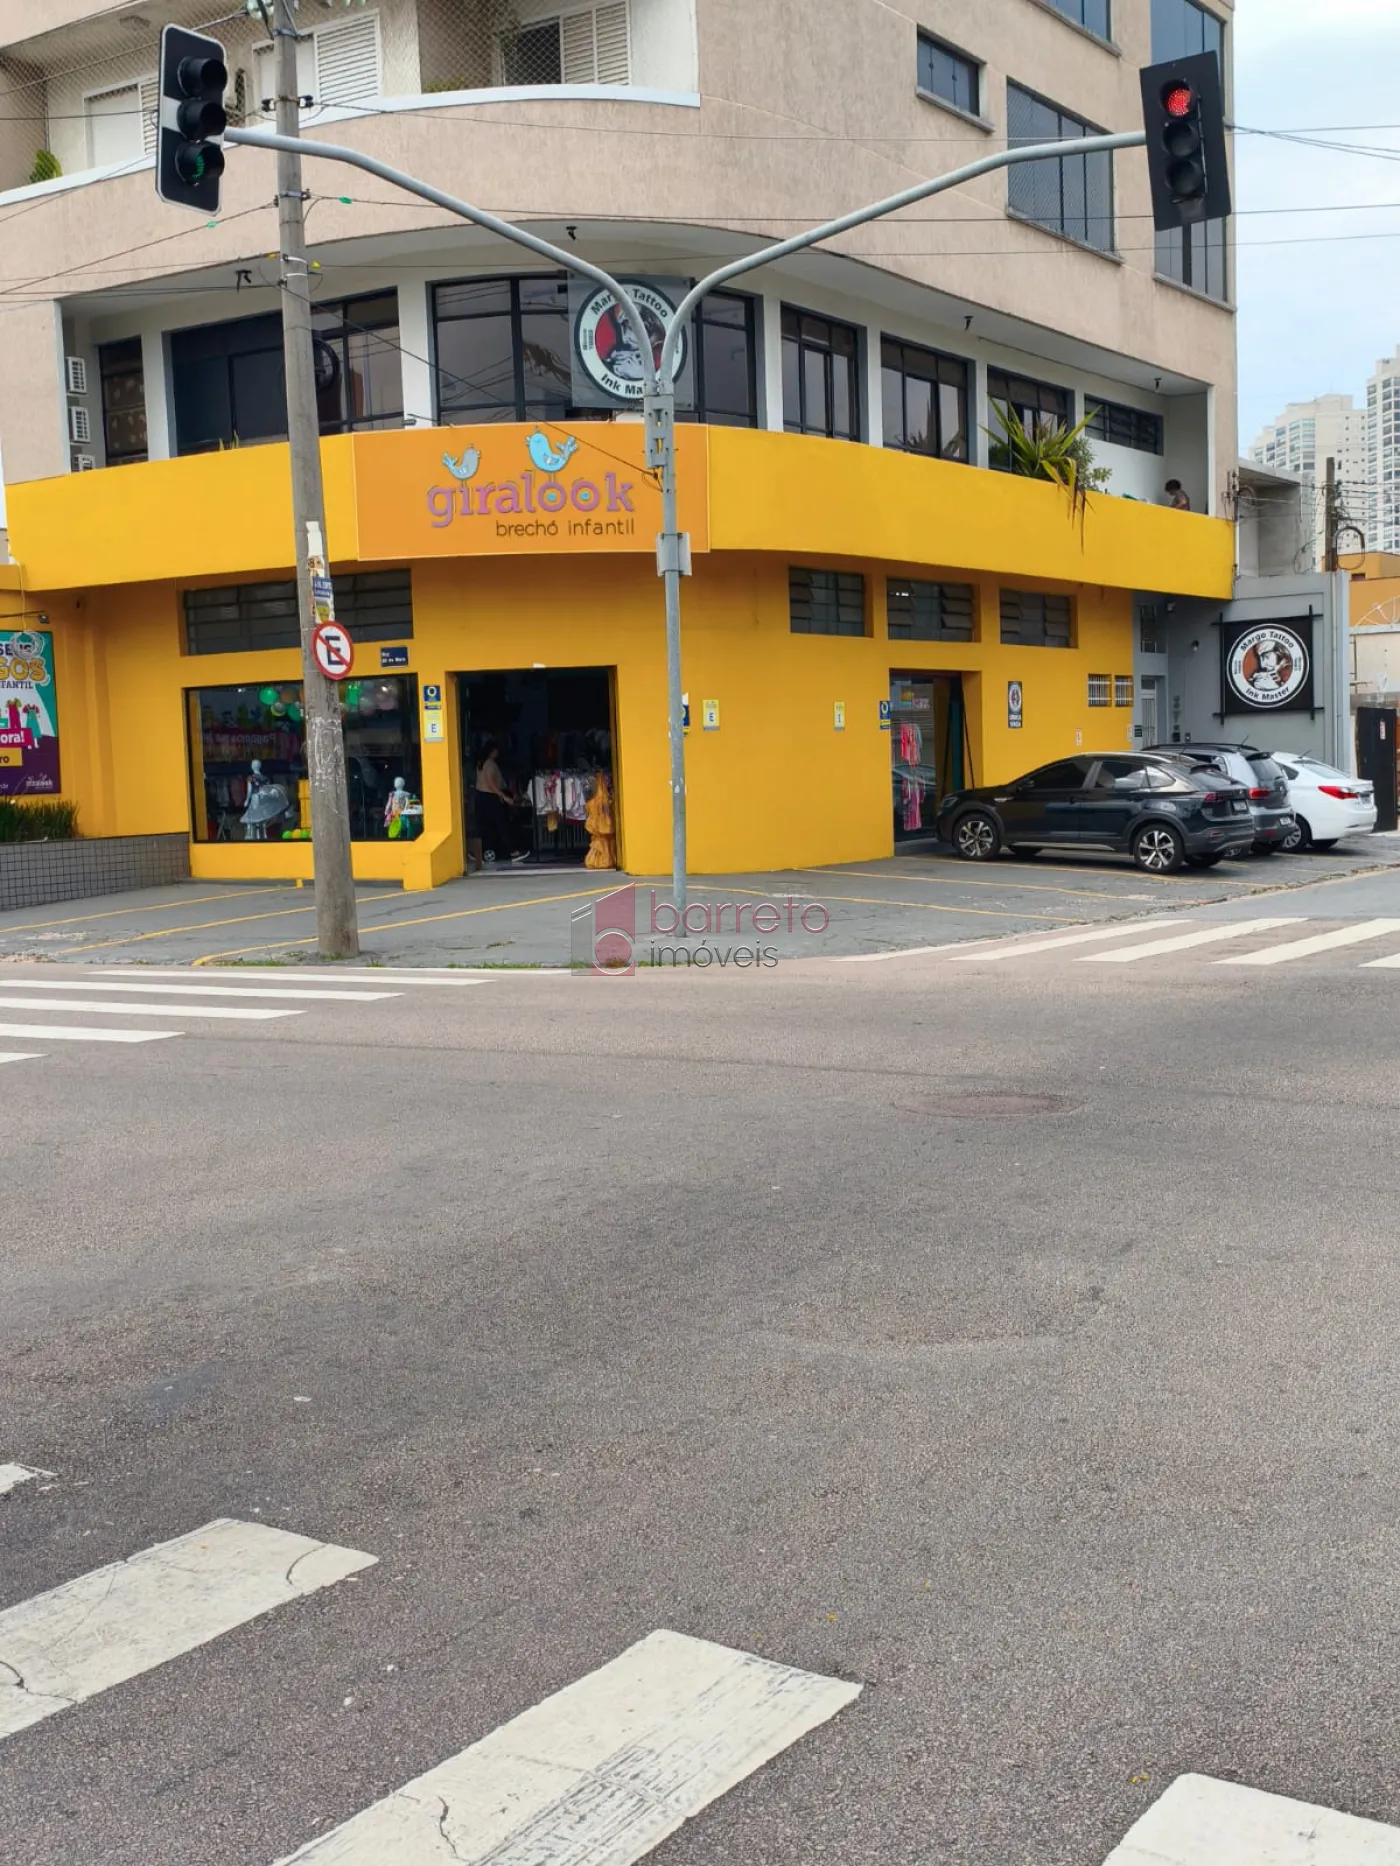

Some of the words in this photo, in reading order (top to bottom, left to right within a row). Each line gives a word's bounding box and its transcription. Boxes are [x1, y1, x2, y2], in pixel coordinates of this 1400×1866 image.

[632, 289, 668, 318] Tattoo
[602, 374, 620, 392] Ink
[427, 472, 635, 528] giralook
[496, 518, 558, 537] brechó
[568, 518, 635, 536] infantil
[1269, 631, 1294, 648] Tattoo
[1245, 687, 1260, 700] Ink
[1261, 686, 1290, 700] Master
